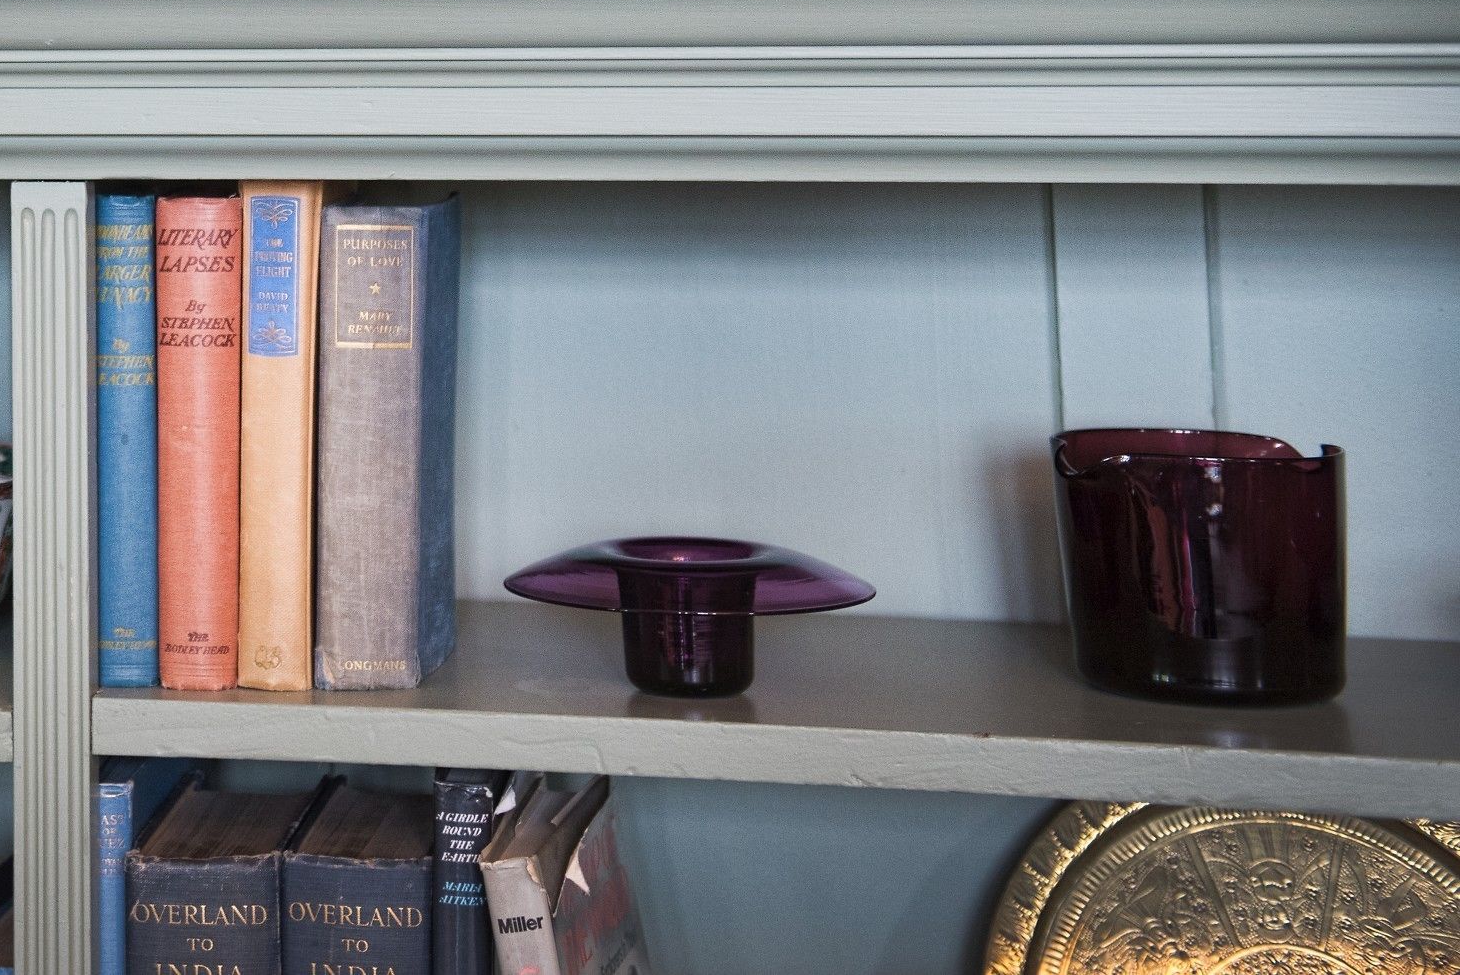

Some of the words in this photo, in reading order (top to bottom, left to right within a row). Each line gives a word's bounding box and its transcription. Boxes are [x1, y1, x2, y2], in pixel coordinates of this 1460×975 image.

[158, 228, 239, 249] LITERARY
[342, 238, 408, 250] PURPOSES
[160, 256, 235, 273] LAPSES
[347, 256, 365, 267] OF
[370, 256, 403, 267] LOVE
[100, 265, 151, 282] ARGER
[255, 266, 291, 278] FLIGHT
[258, 291, 288, 300] DAVID
[185, 300, 206, 314] By
[359, 311, 393, 322] MARY
[161, 317, 234, 331] STEPHEN
[160, 332, 237, 347] LEACOCK
[187, 631, 209, 642] THE
[203, 645, 230, 654] HEAD
[101, 814, 124, 825] AST
[445, 812, 489, 823] GIRDLE
[442, 825, 482, 837] ROUND
[449, 839, 475, 850] THE
[442, 882, 482, 893] MARIA
[132, 902, 267, 925] OVERLAND
[289, 902, 423, 927] OVERLAND
[498, 916, 543, 934] Miller
[187, 938, 214, 951] TO
[342, 938, 369, 953] TO
